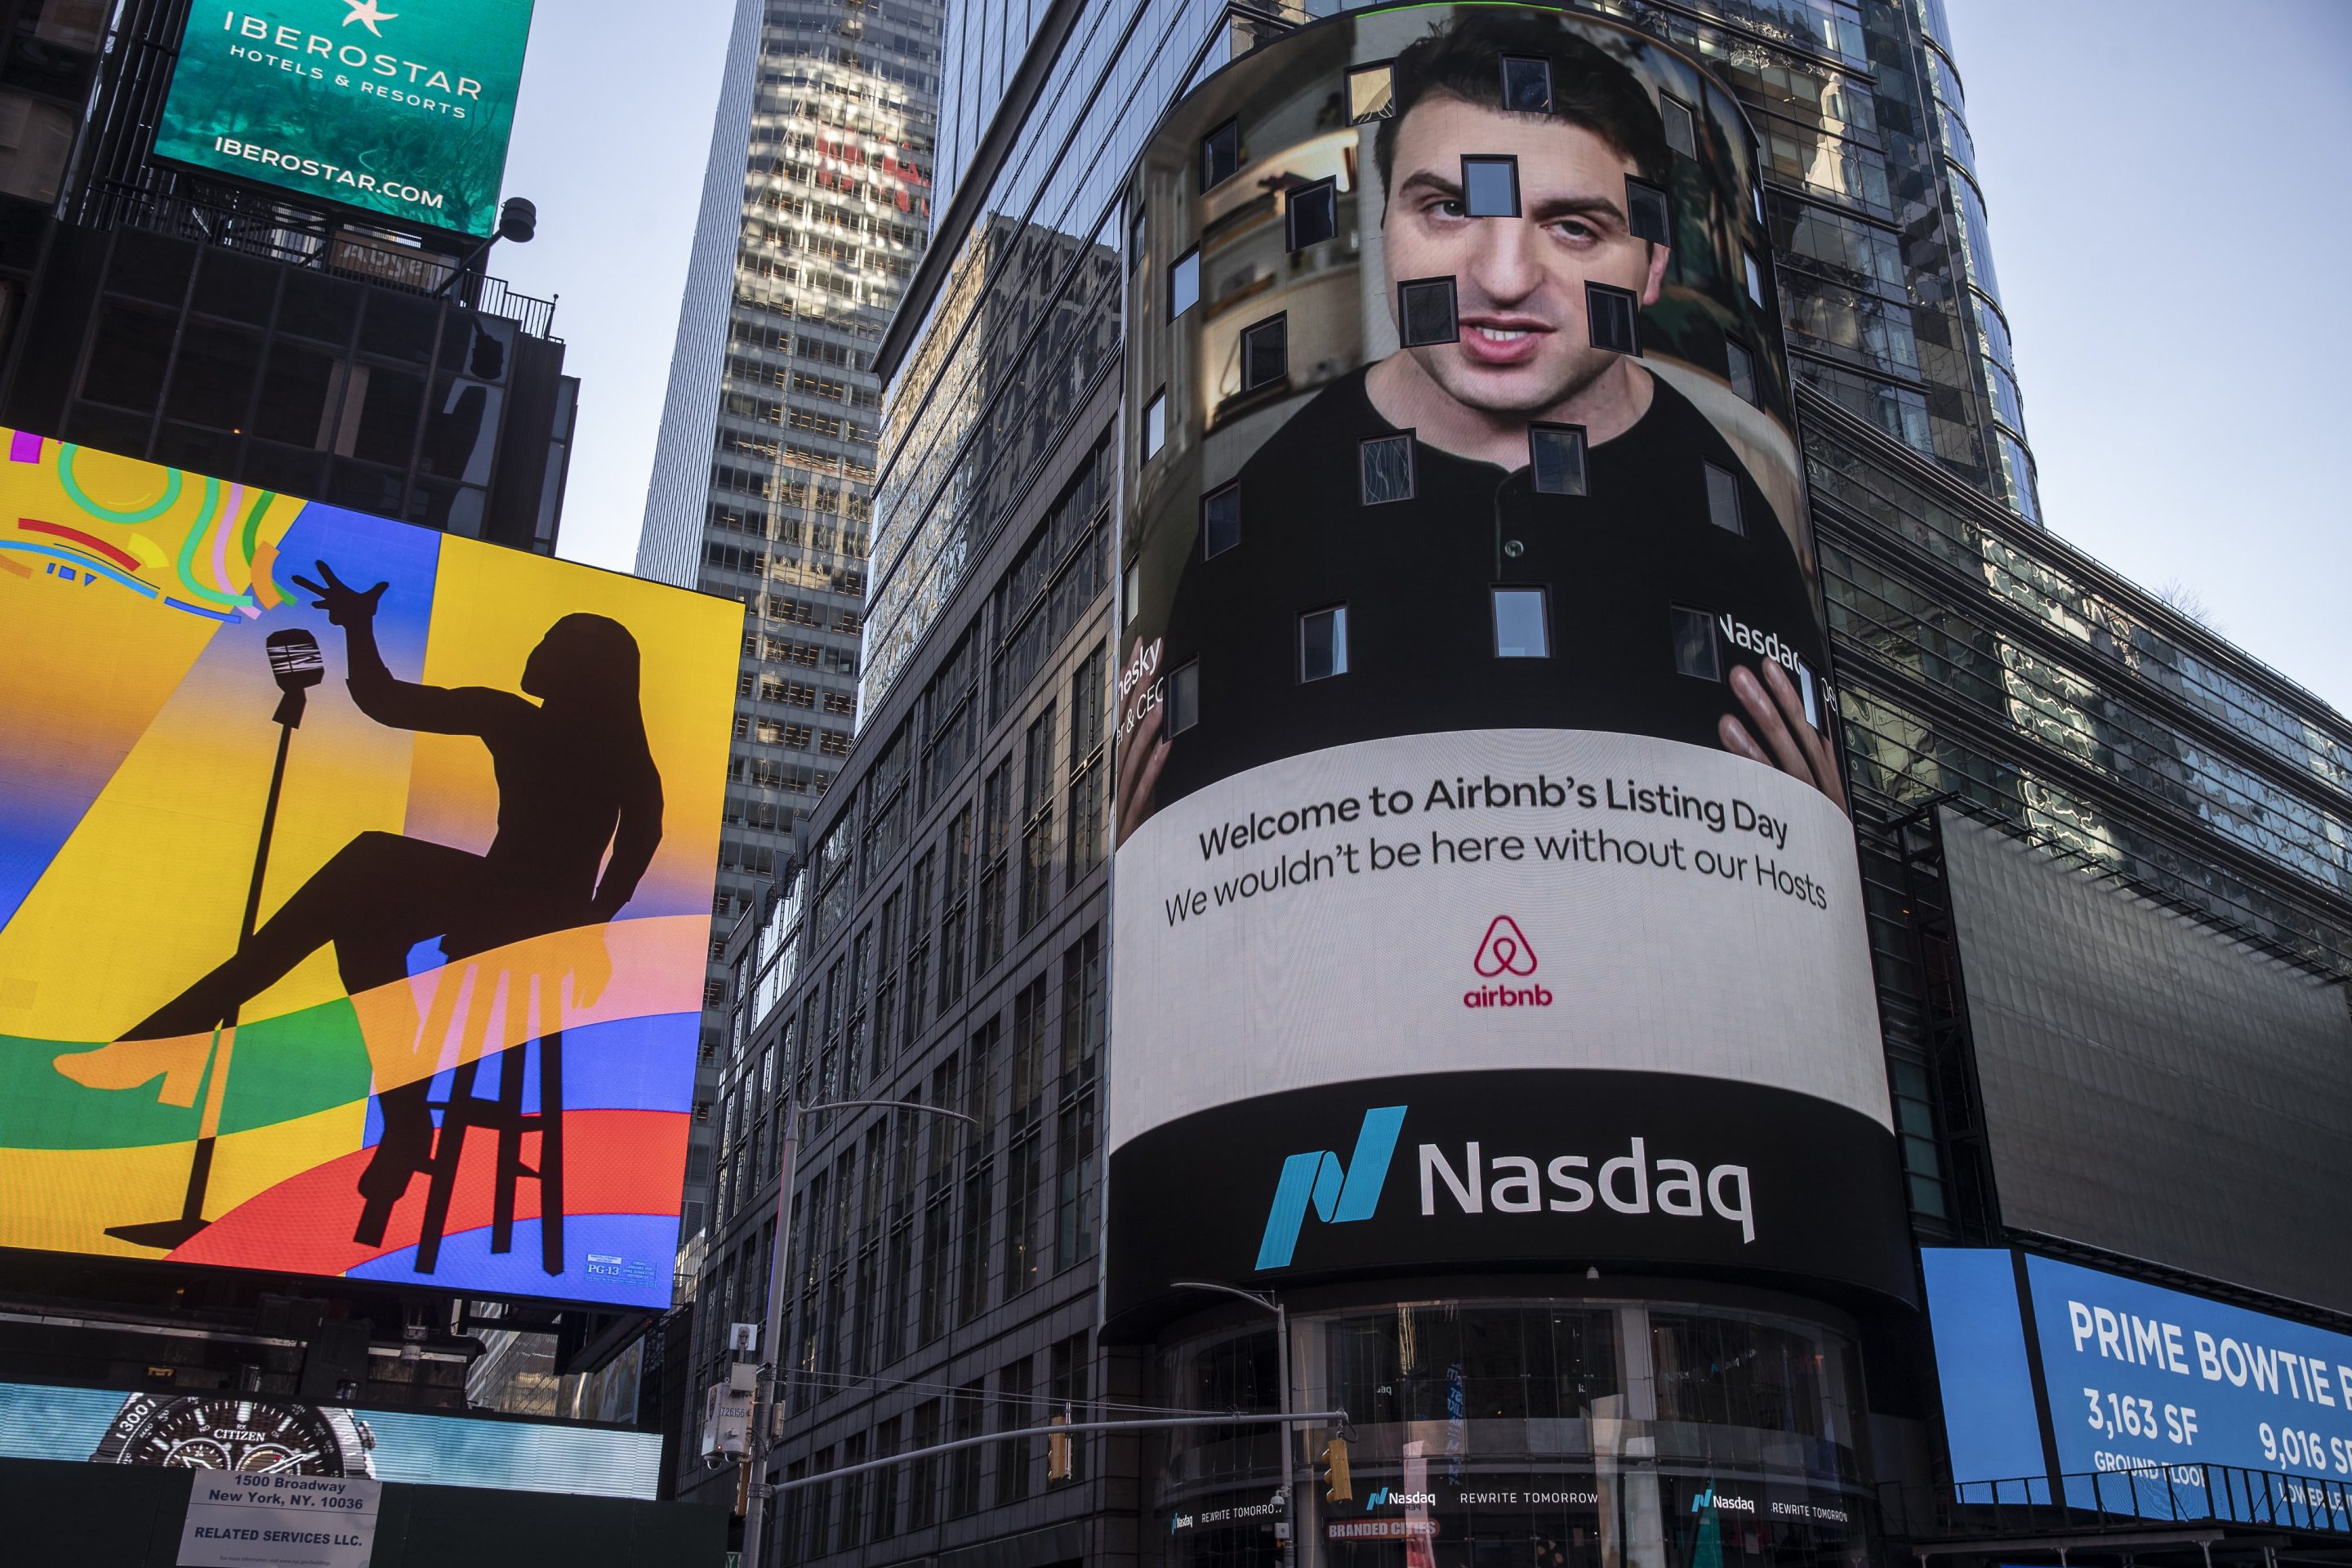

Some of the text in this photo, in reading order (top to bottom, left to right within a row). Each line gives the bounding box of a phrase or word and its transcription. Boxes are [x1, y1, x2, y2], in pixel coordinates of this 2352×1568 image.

[223, 10, 483, 101] IBEROSTAR
[229, 44, 468, 120] HOTELS & RESORTS
[214, 136, 444, 210] IBEROSTAR.COM
[1126, 708, 1135, 734] &
[1199, 797, 1361, 862] Welcome
[1369, 786, 1414, 817] to
[1606, 777, 1726, 833] Listing
[1731, 798, 1788, 850] Day
[1165, 888, 1208, 928] We
[1370, 837, 1421, 871] be
[1432, 831, 1526, 865] here
[1535, 828, 1687, 871] without
[1695, 849, 1748, 882] our
[1755, 854, 1828, 911] Hosts
[1463, 983, 1553, 1009] airbnb
[1419, 1136, 1756, 1245] Nasdaq
[587, 1263, 620, 1276] PG-13
[2068, 1299, 2190, 1375] PRIME
[2194, 1330, 2336, 1407] BOWTIE
[721, 1406, 746, 1419] 726156
[2083, 1388, 2198, 1446] 3,163 SF
[213, 1428, 266, 1443] CITIZEN
[2259, 1422, 2327, 1471] 9,016
[2094, 1450, 2160, 1480] GROUND
[234, 1474, 346, 1495] 1500 Broadway
[208, 1489, 364, 1510] New York, NY. 10036
[1388, 1490, 1436, 1506] Nasdaq
[1460, 1492, 1598, 1503] REWRITE TOMORROW
[1713, 1495, 1755, 1513] Nasdaq
[1176, 1513, 1193, 1529] Nasdaq
[1201, 1503, 1283, 1524] REWRITE TOMORRO
[1771, 1502, 1848, 1523] REWRITE TOMORROW
[194, 1526, 363, 1547] RELATED SERVICES LLC.
[1329, 1521, 1437, 1539] BRANDED CITIES
